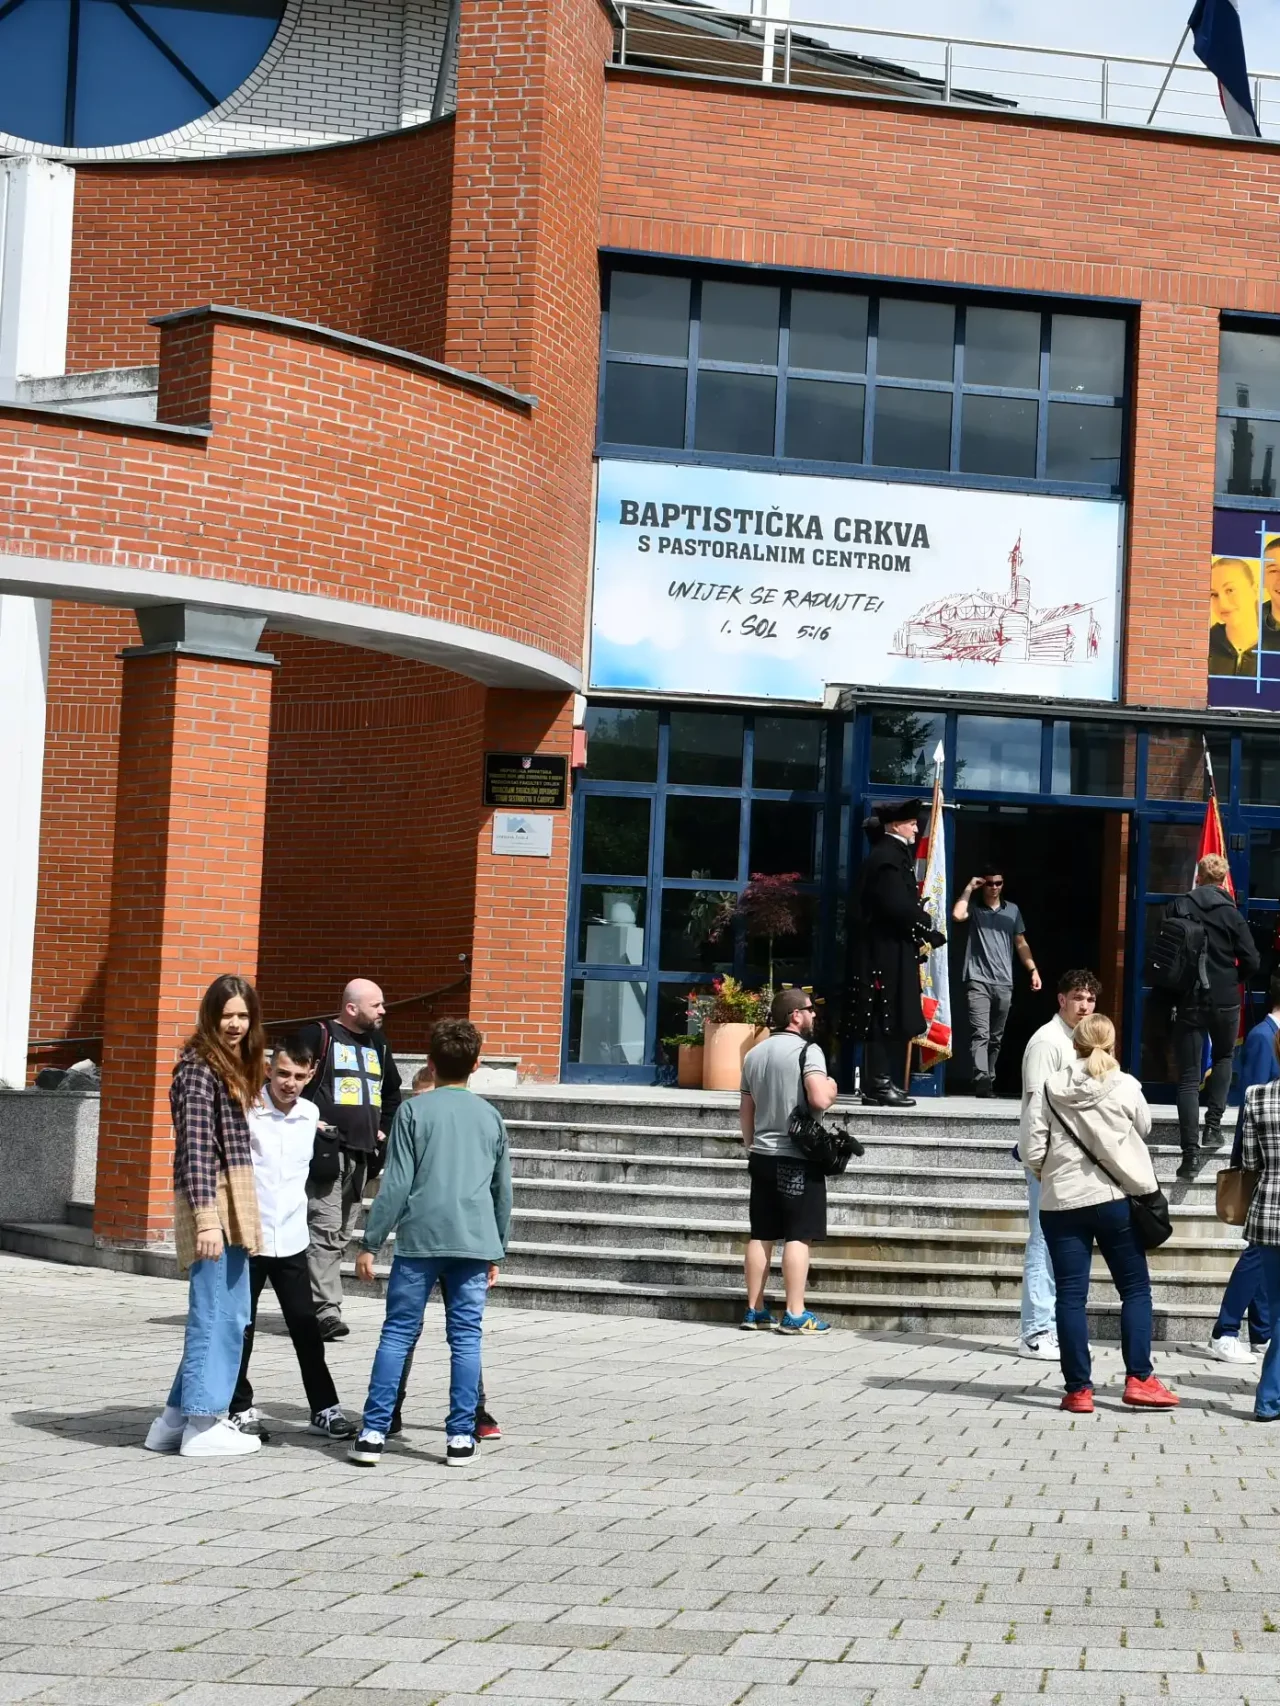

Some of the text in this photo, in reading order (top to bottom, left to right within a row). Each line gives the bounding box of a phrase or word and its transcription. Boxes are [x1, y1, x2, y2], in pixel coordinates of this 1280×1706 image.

[619, 499, 931, 549] BAPTISTIČKA CRKVA
[637, 535, 911, 573] S PASTORALNIM CENTROM
[749, 586, 779, 605] SE
[781, 589, 884, 614] RADUJTE!
[740, 614, 778, 639] SOL
[796, 624, 832, 641] 5:16
